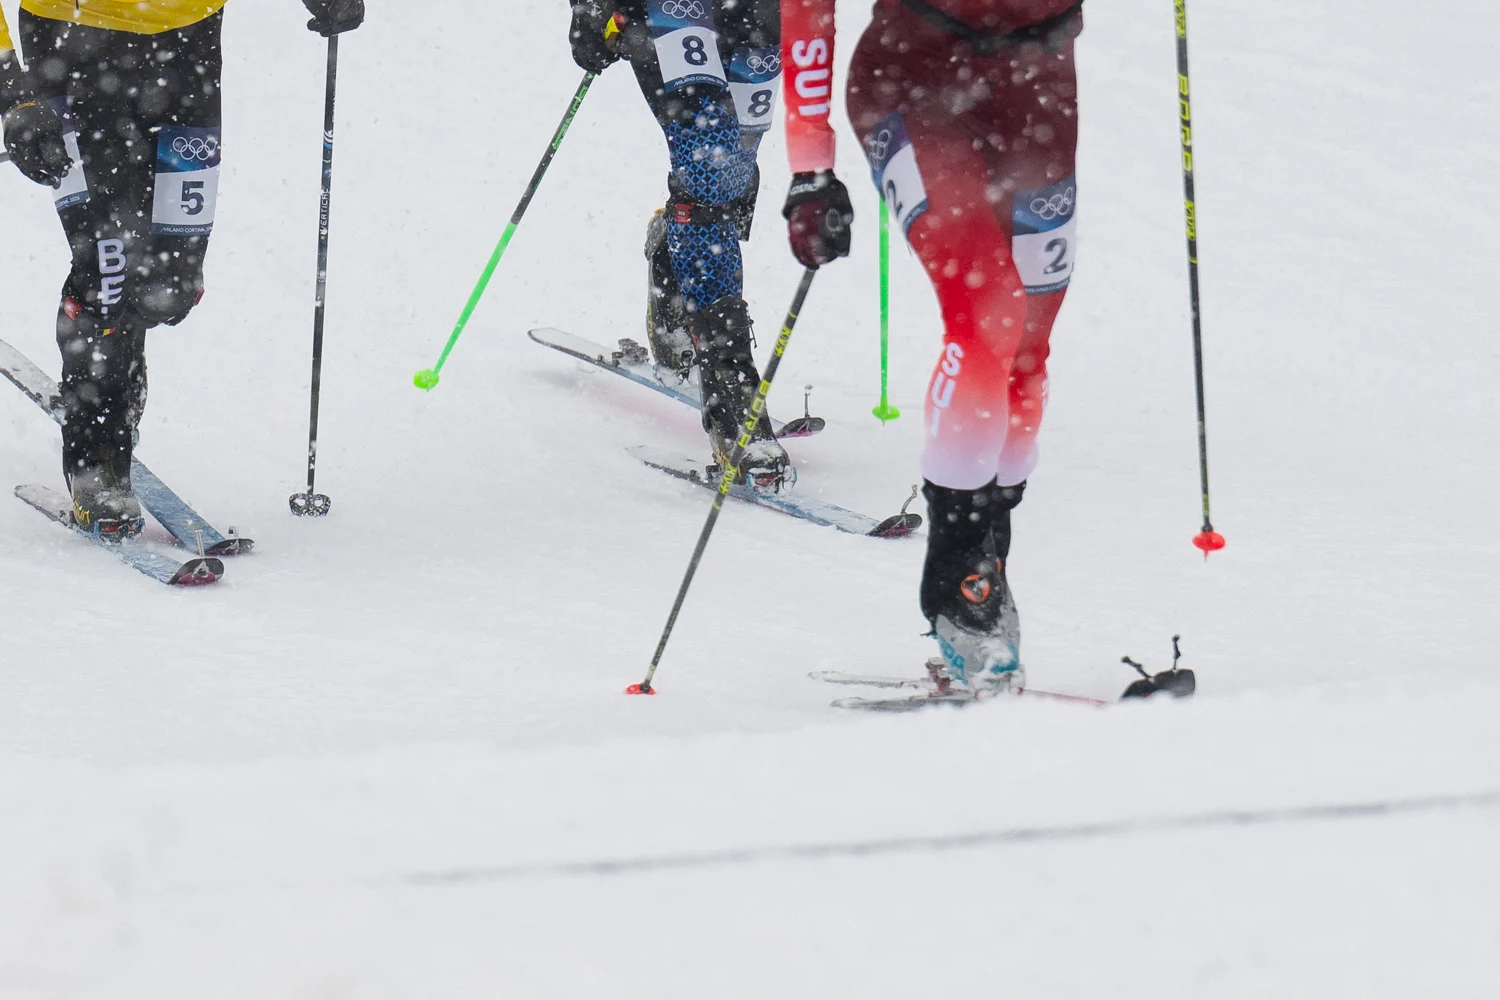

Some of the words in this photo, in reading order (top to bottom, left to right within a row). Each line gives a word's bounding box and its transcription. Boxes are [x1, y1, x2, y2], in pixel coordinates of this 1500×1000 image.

[682, 35, 708, 67] 8
[791, 38, 829, 117] SUI
[747, 89, 773, 118] 8
[180, 180, 205, 216] 5
[1043, 237, 1067, 275] 2
[97, 238, 127, 315] BE
[930, 341, 966, 438] SUI
